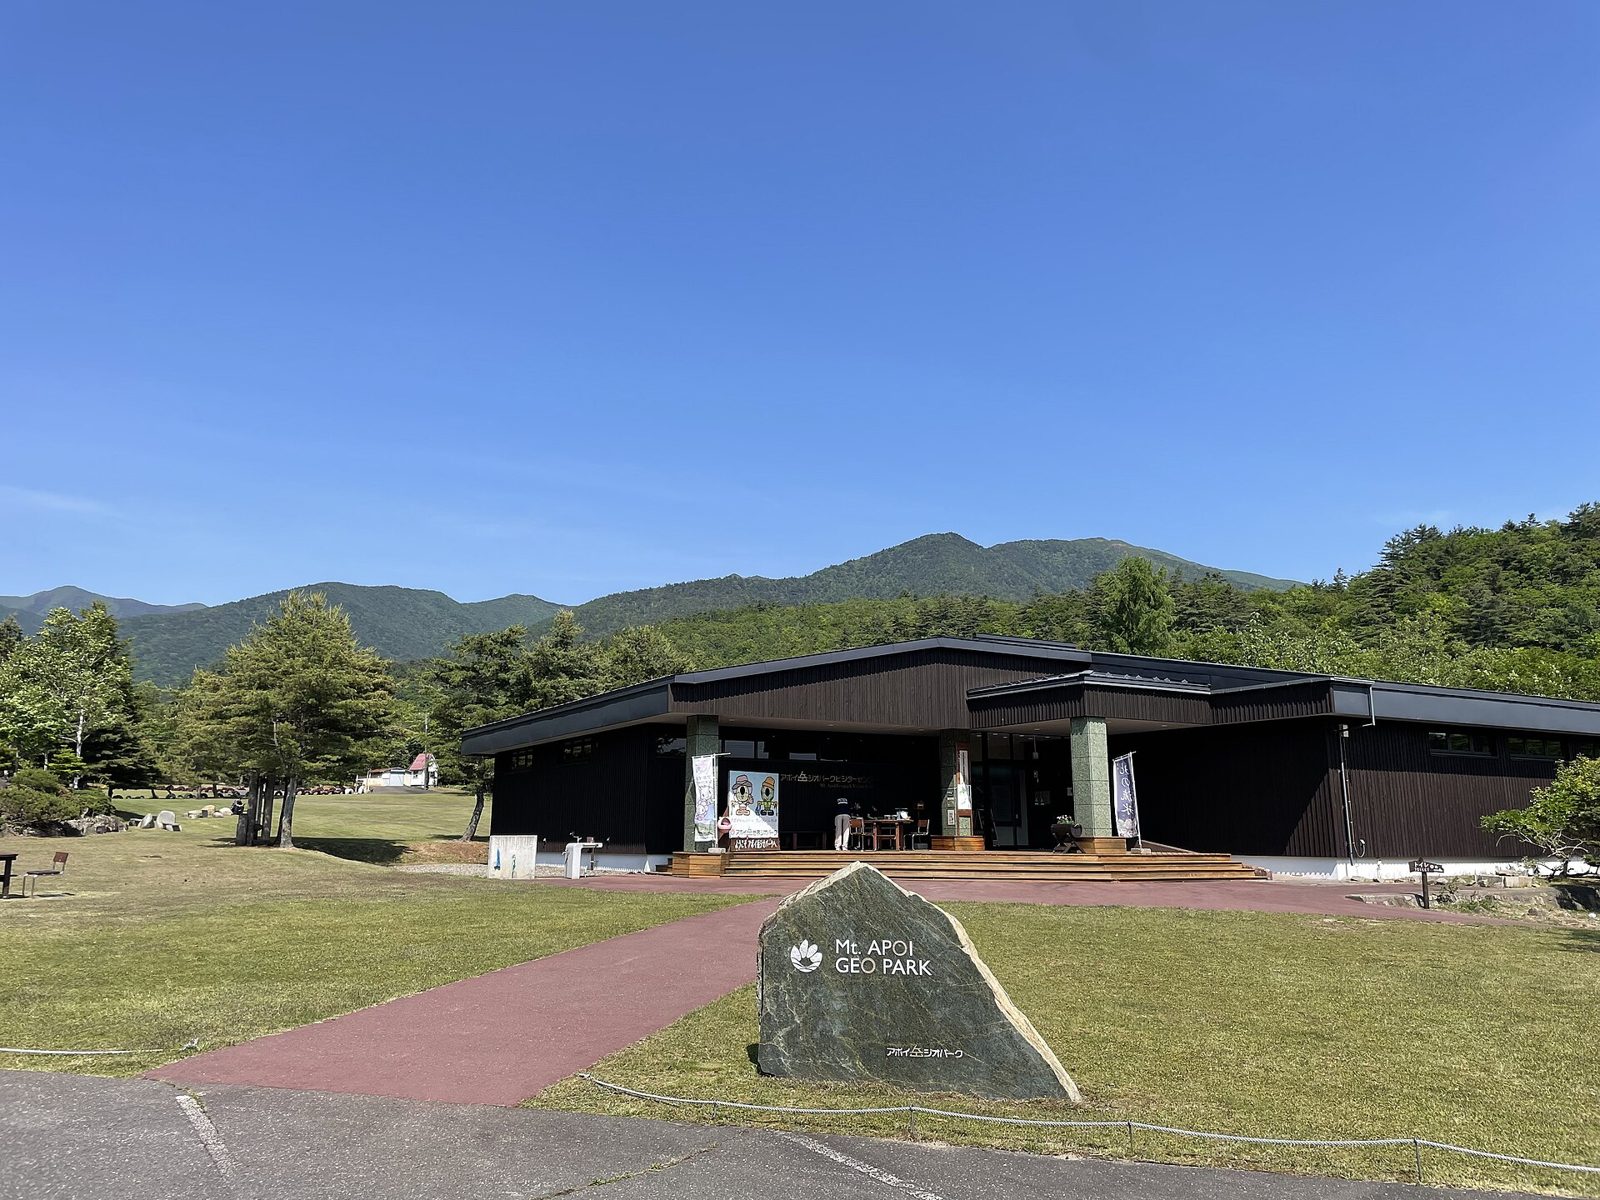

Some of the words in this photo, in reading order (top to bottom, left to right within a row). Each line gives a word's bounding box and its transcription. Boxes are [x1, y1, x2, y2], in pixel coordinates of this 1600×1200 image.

[835, 939, 861, 955] Mt.
[867, 940, 913, 956] APOI
[835, 957, 876, 974] GEO
[883, 959, 932, 976] PARK
[886, 1044, 963, 1058] アポイ岳ジオパーク
